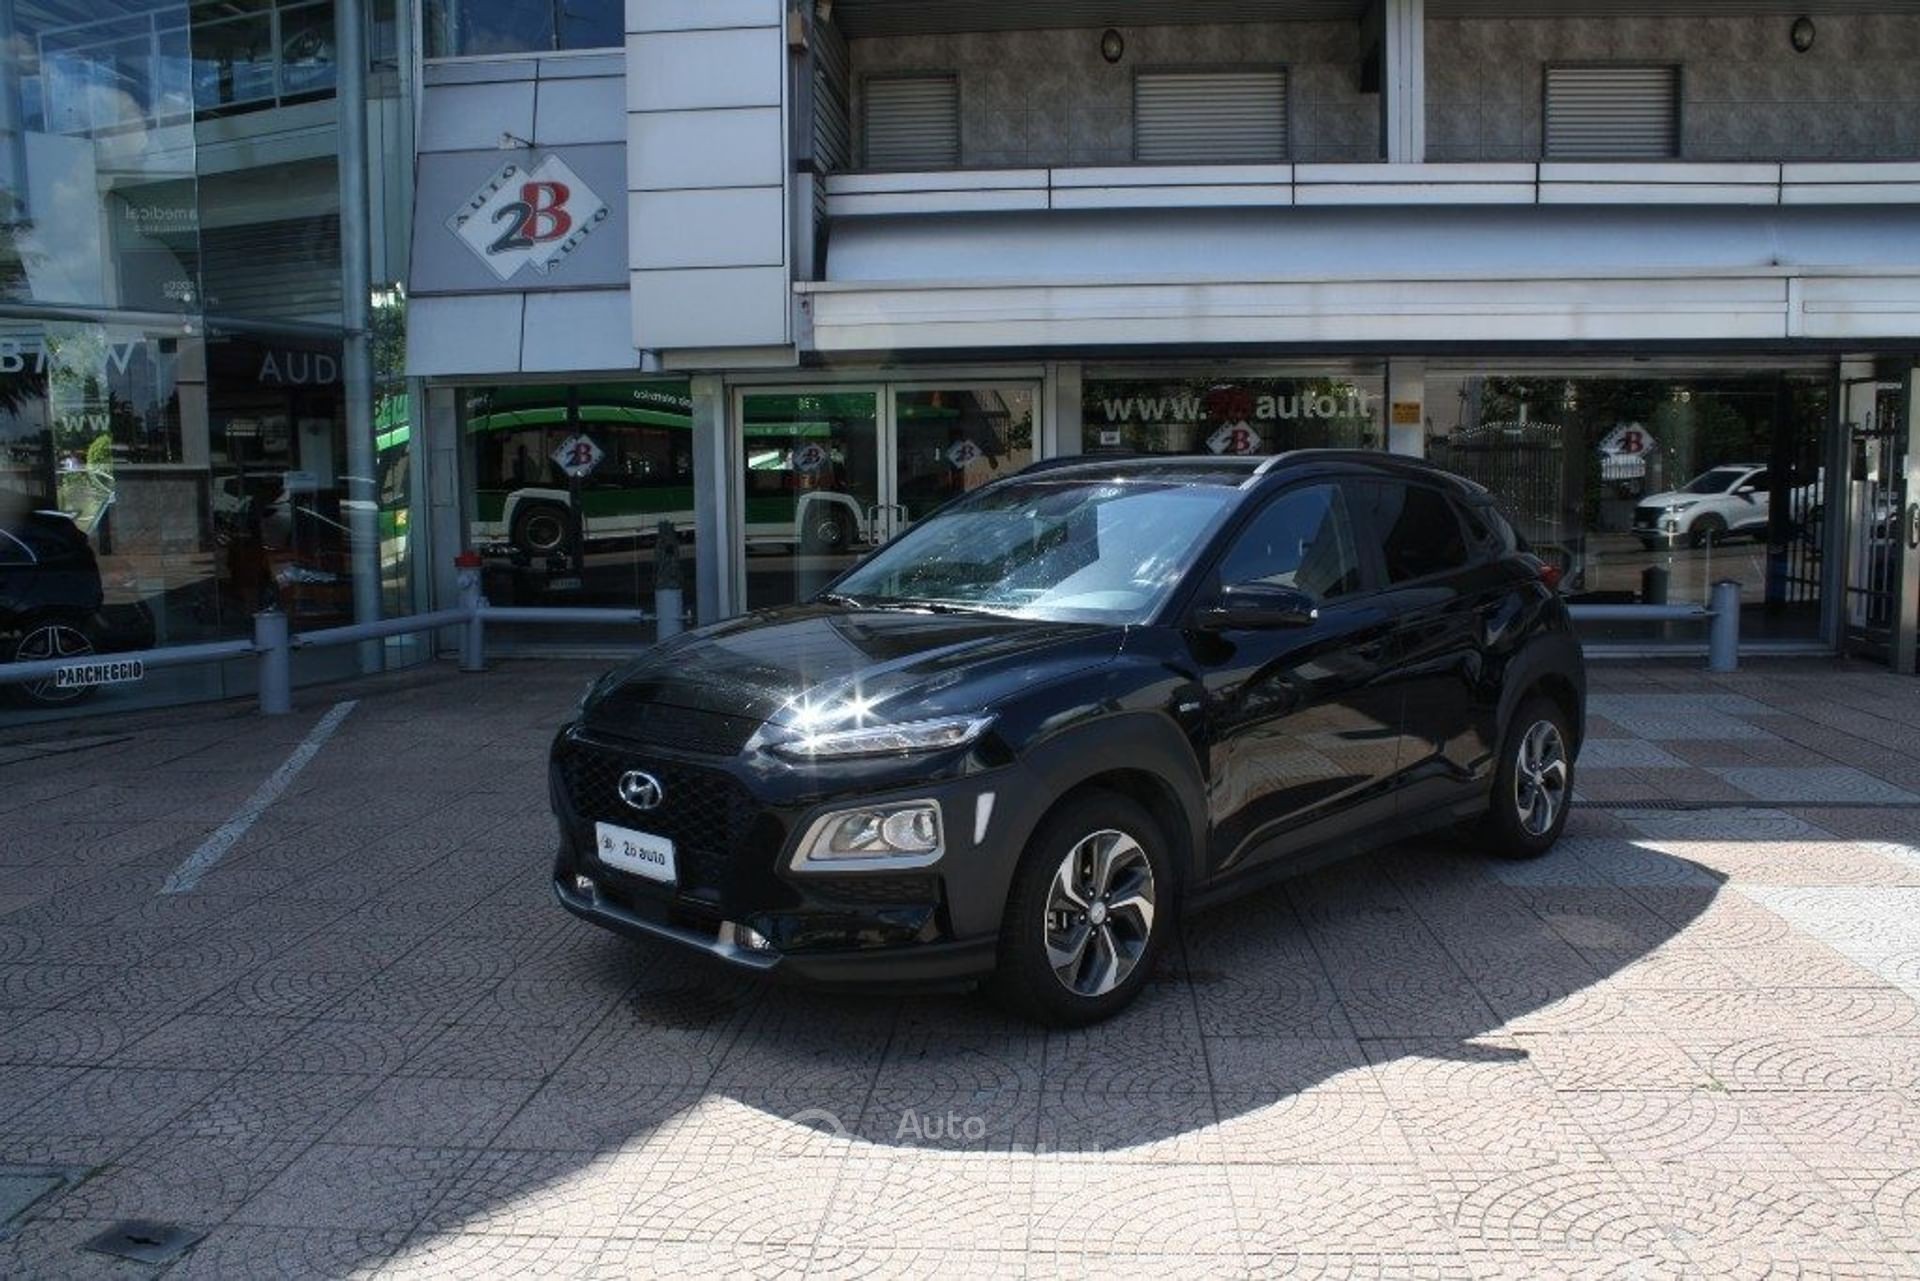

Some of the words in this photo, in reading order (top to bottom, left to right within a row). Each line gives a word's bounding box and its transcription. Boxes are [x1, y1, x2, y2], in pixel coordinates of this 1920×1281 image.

[456, 164, 516, 227] AUTO
[486, 181, 572, 256] 2B
[547, 208, 608, 272] AUTO
[258, 350, 343, 384] AUD
[58, 661, 142, 685] PARCHEGGIO
